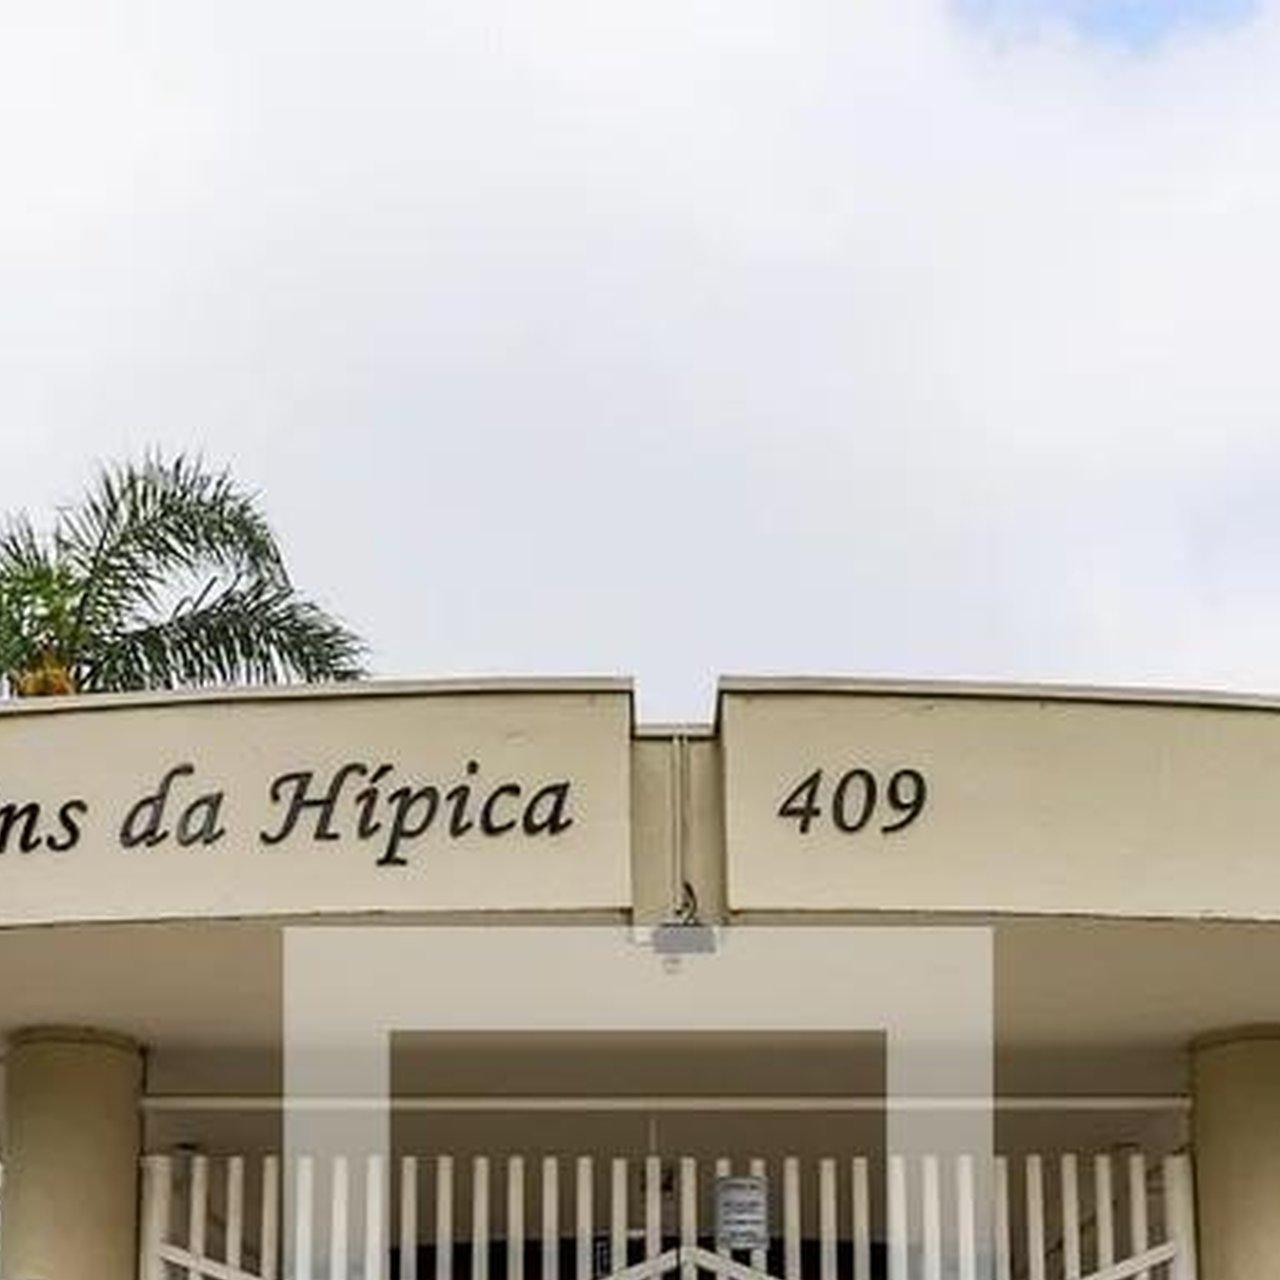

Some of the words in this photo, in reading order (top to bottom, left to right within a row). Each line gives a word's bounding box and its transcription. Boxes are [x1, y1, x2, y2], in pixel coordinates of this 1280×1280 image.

[119, 763, 226, 849] da
[259, 759, 575, 868] Hípica
[776, 767, 928, 836] 409
